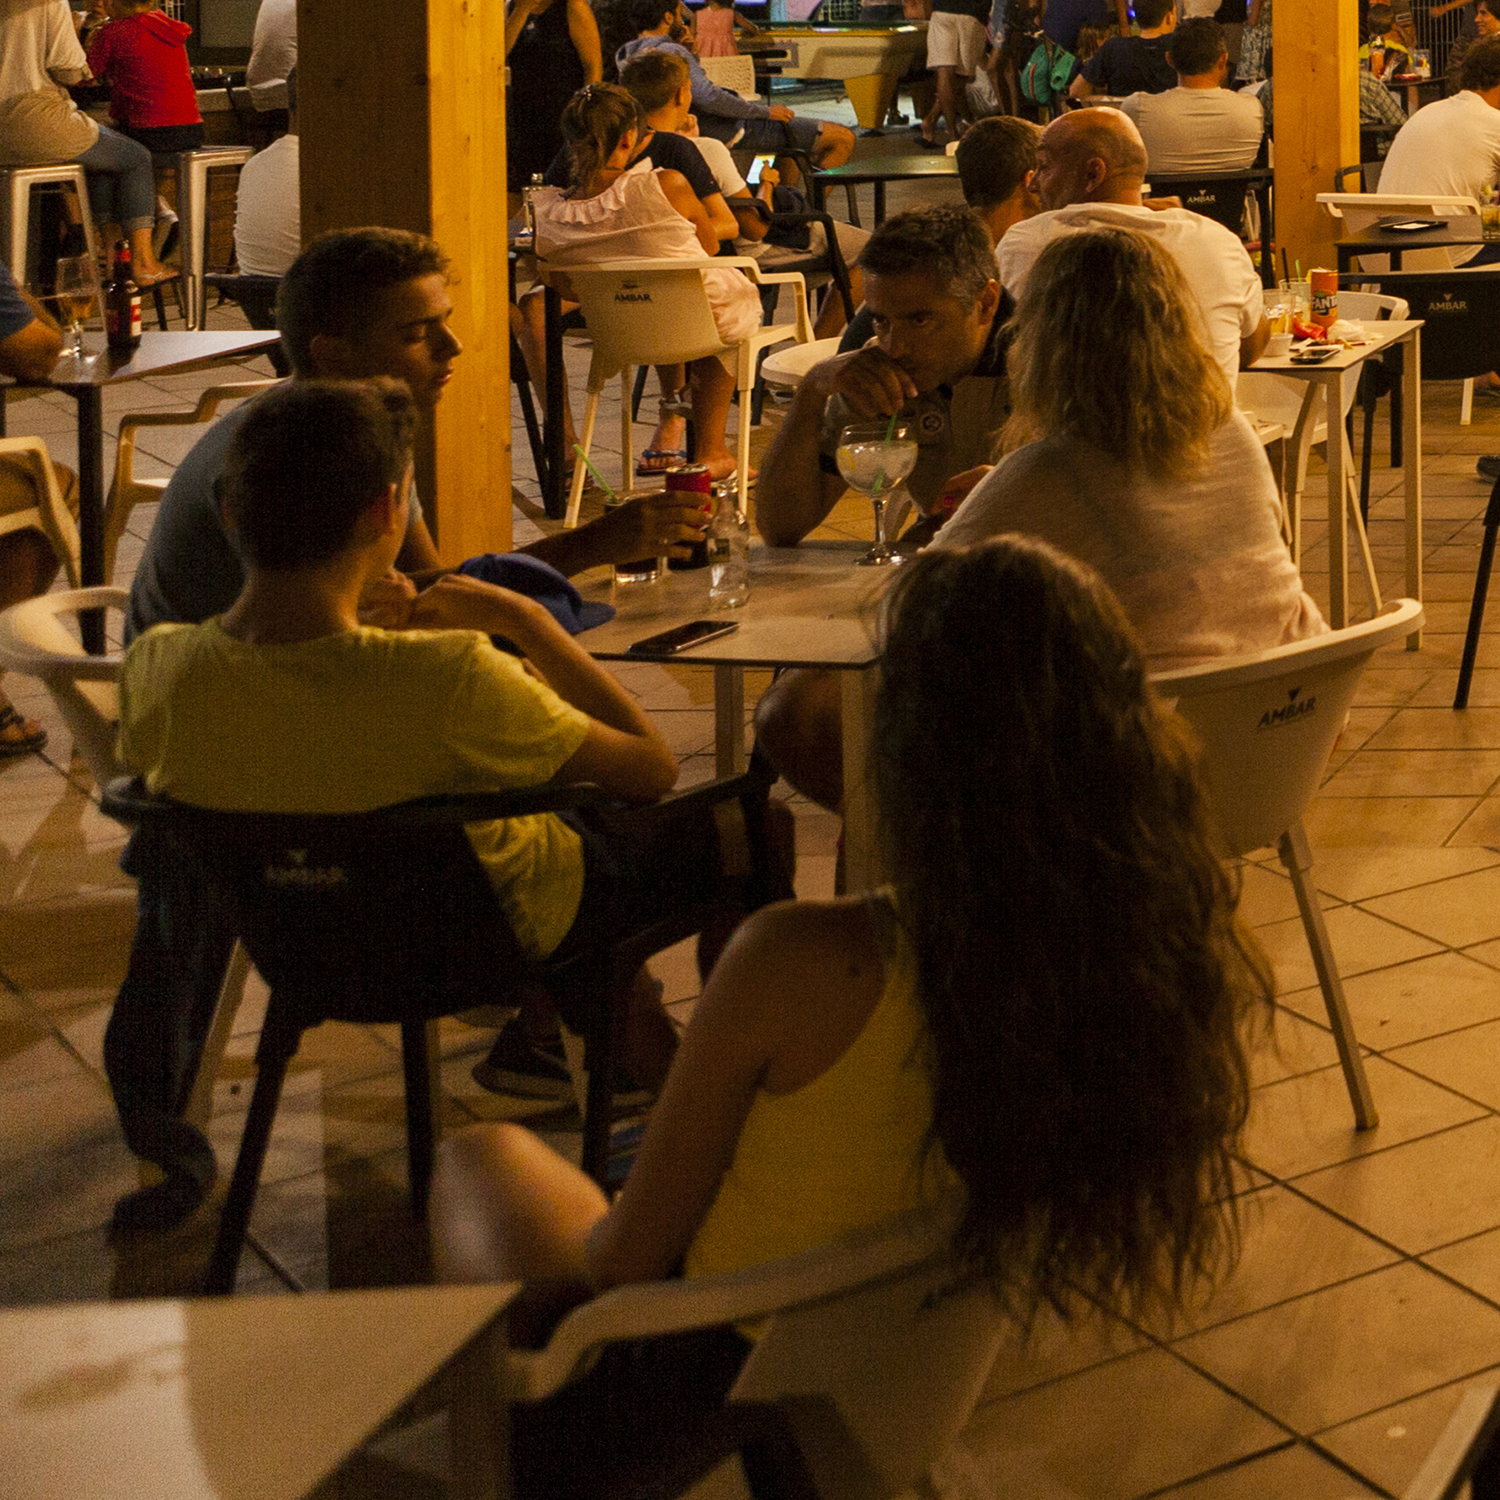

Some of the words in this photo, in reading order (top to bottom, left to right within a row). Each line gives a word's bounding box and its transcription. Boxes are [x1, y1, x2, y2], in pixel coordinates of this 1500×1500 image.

[1187, 194, 1216, 203] AMBAR
[614, 293, 653, 302] AMBAR
[1428, 301, 1467, 312] AMBAR
[1258, 696, 1317, 728] AMBAR
